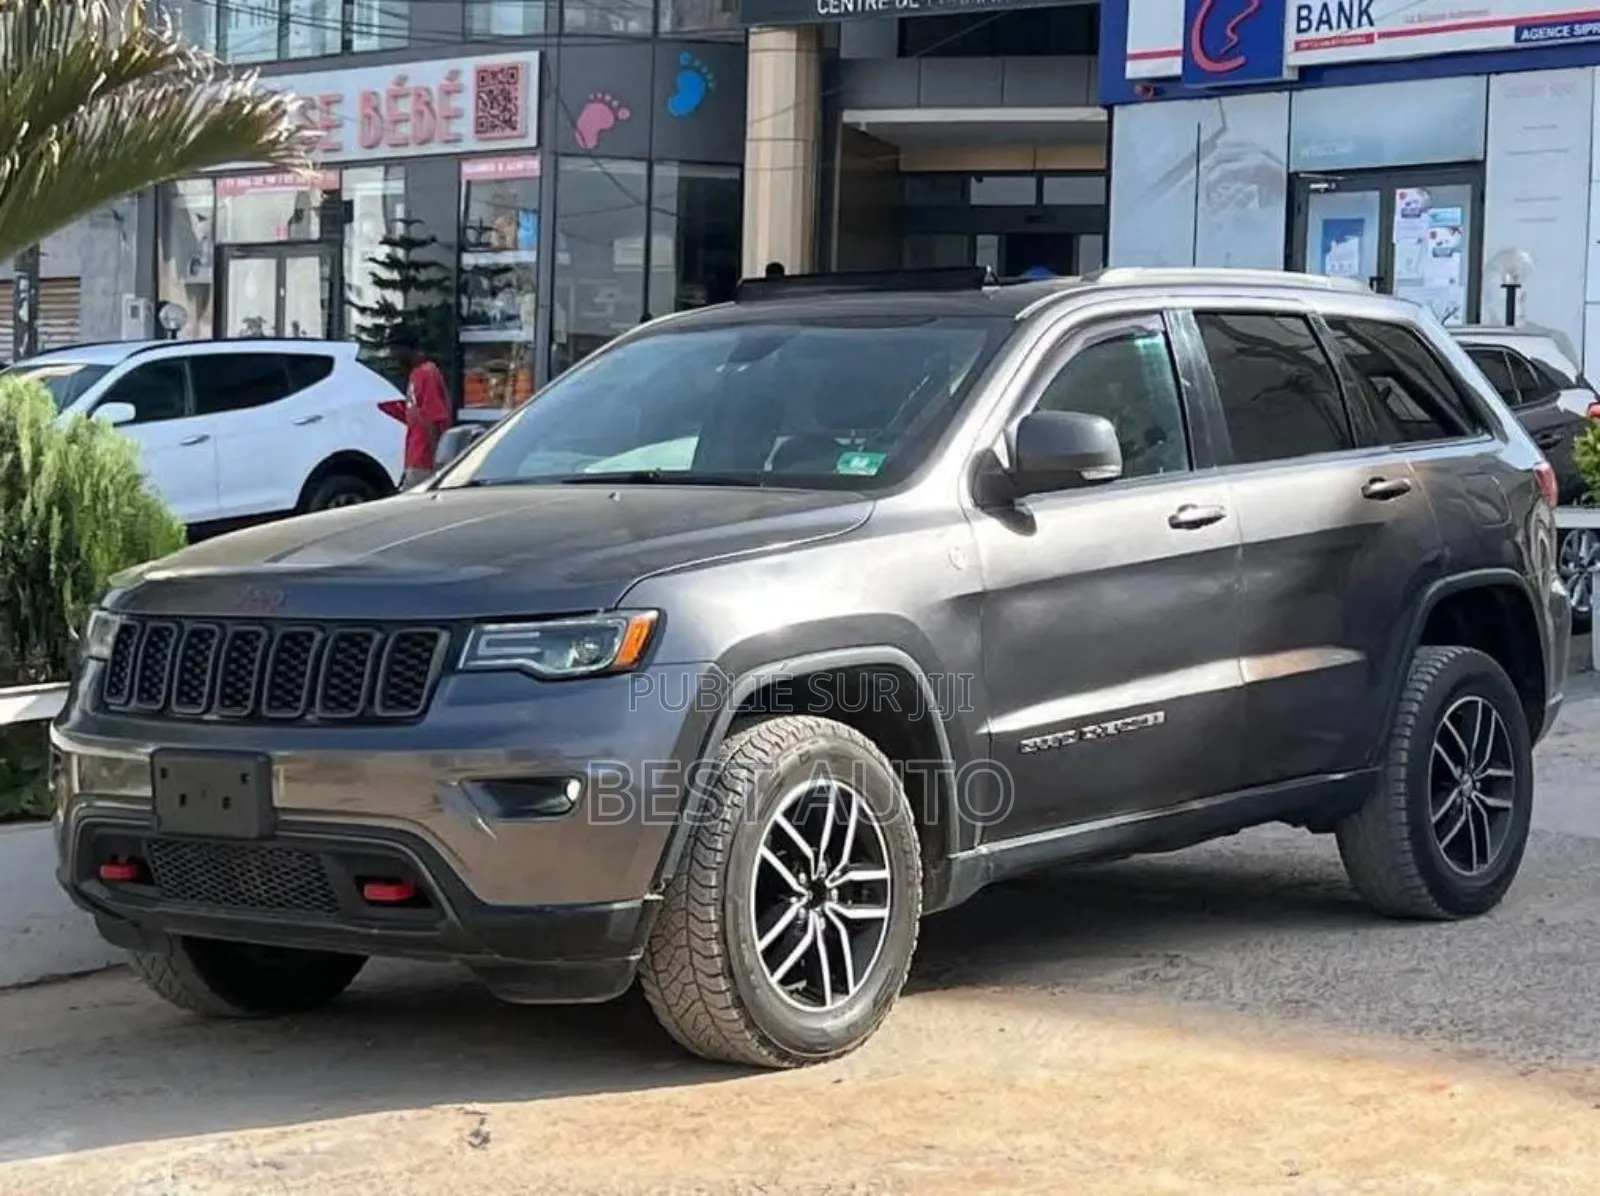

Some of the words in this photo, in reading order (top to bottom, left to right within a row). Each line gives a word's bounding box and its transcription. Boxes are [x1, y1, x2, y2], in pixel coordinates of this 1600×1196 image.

[1296, 0, 1375, 33] BANK
[1520, 24, 1571, 41] AGENCE
[360, 69, 465, 149] BÉBÉ
